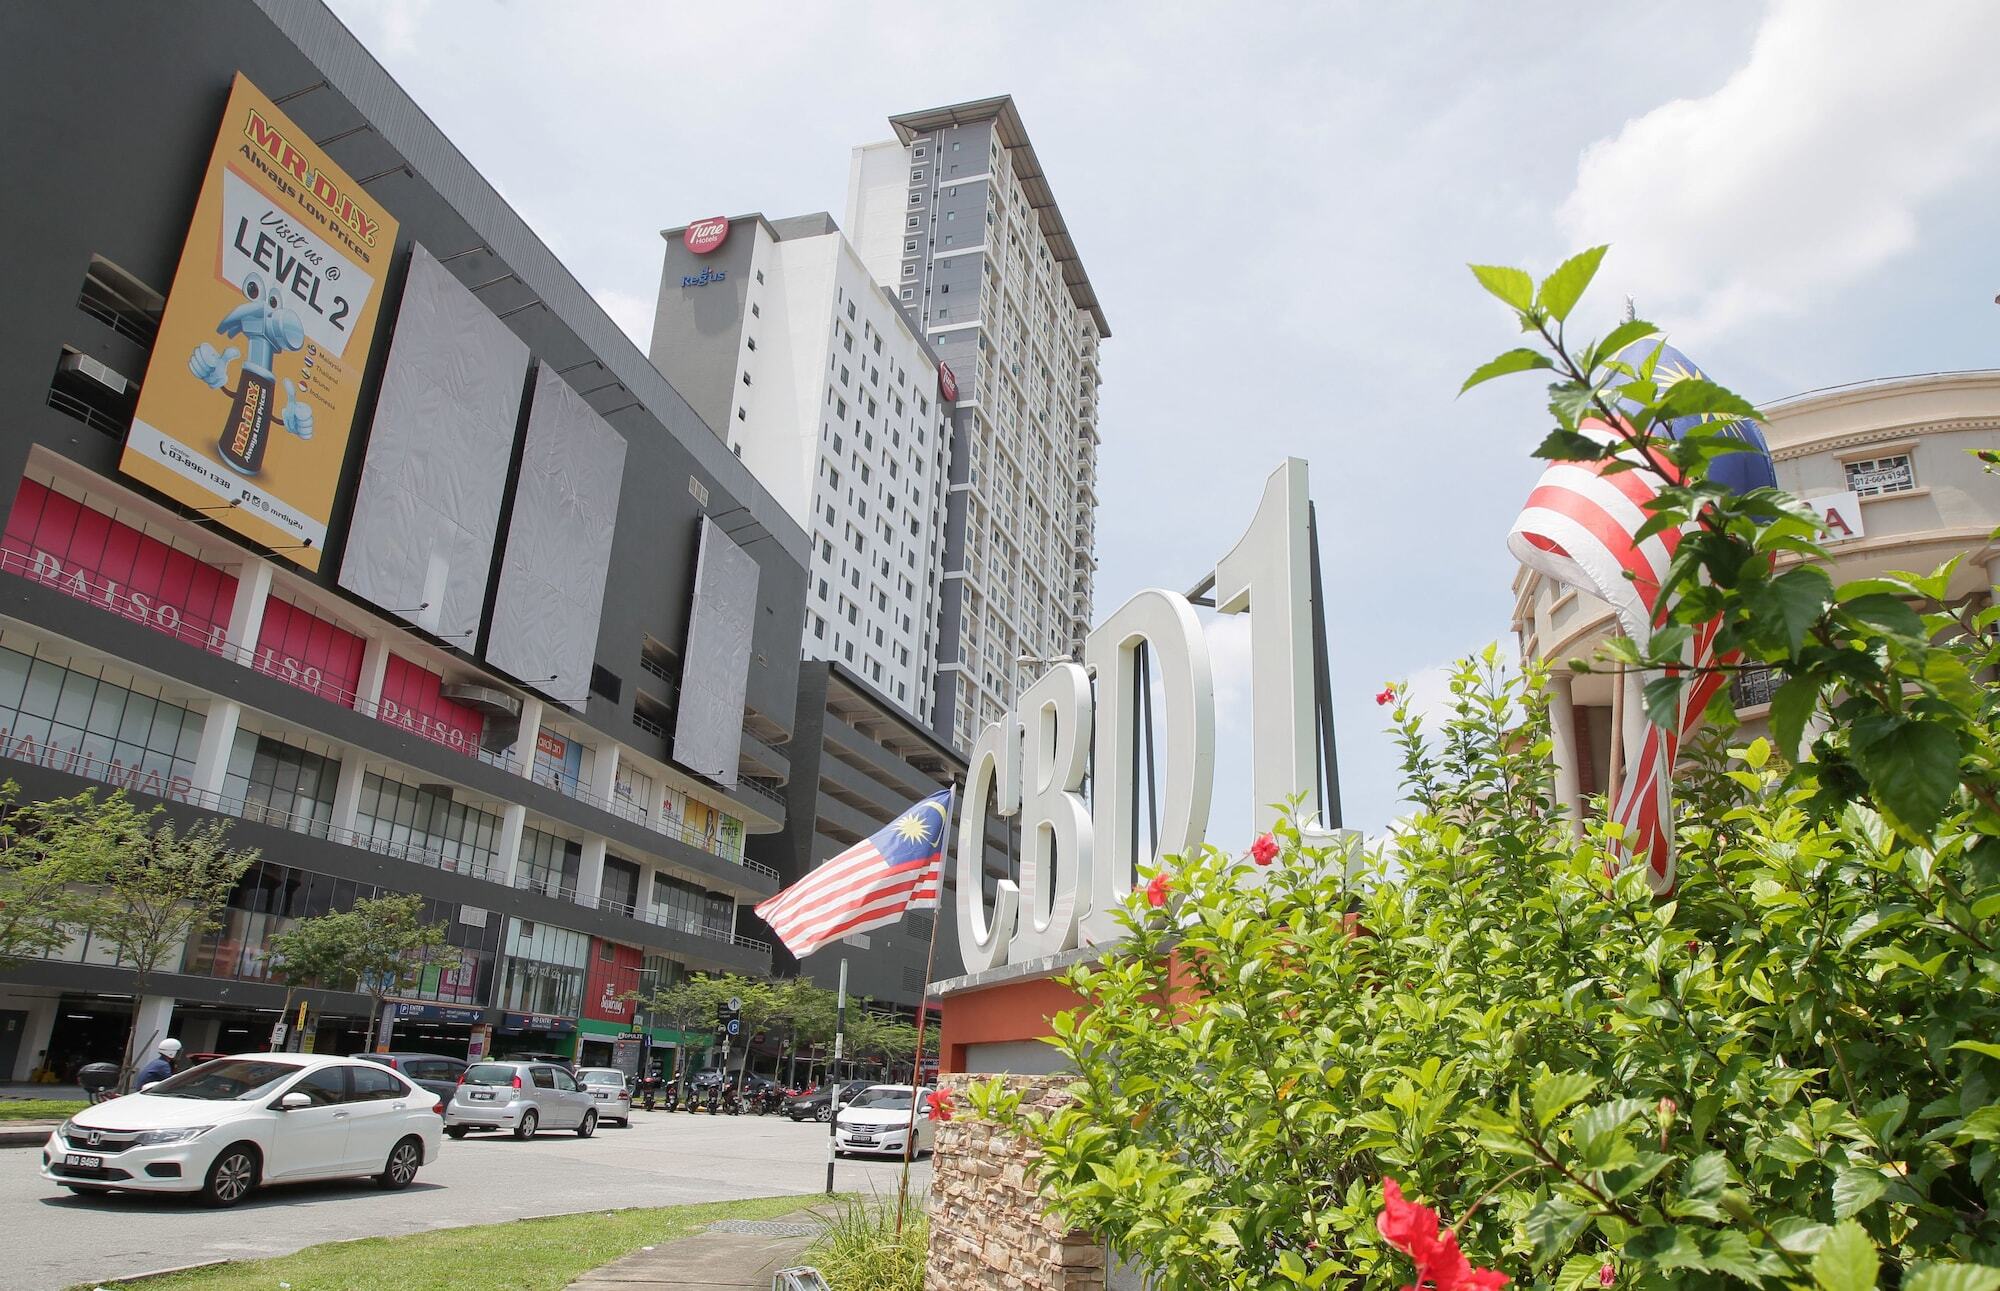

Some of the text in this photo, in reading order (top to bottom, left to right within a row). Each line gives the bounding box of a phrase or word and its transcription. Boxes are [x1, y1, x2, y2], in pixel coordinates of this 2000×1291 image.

[239, 144, 371, 264] Always Low Prices
[259, 210, 341, 282] Visit us @
[690, 220, 725, 244] Tune
[695, 234, 719, 245] Hotels
[233, 215, 350, 332] LEVEL 2
[681, 271, 726, 288] Regus
[243, 388, 267, 463] Always Low Prices
[169, 450, 231, 489] 03-8961 1338
[270, 507, 304, 531] mrdiy2u
[32, 549, 180, 629] DAISO
[383, 699, 463, 747] DAISO
[731, 1023, 738, 1032] P
